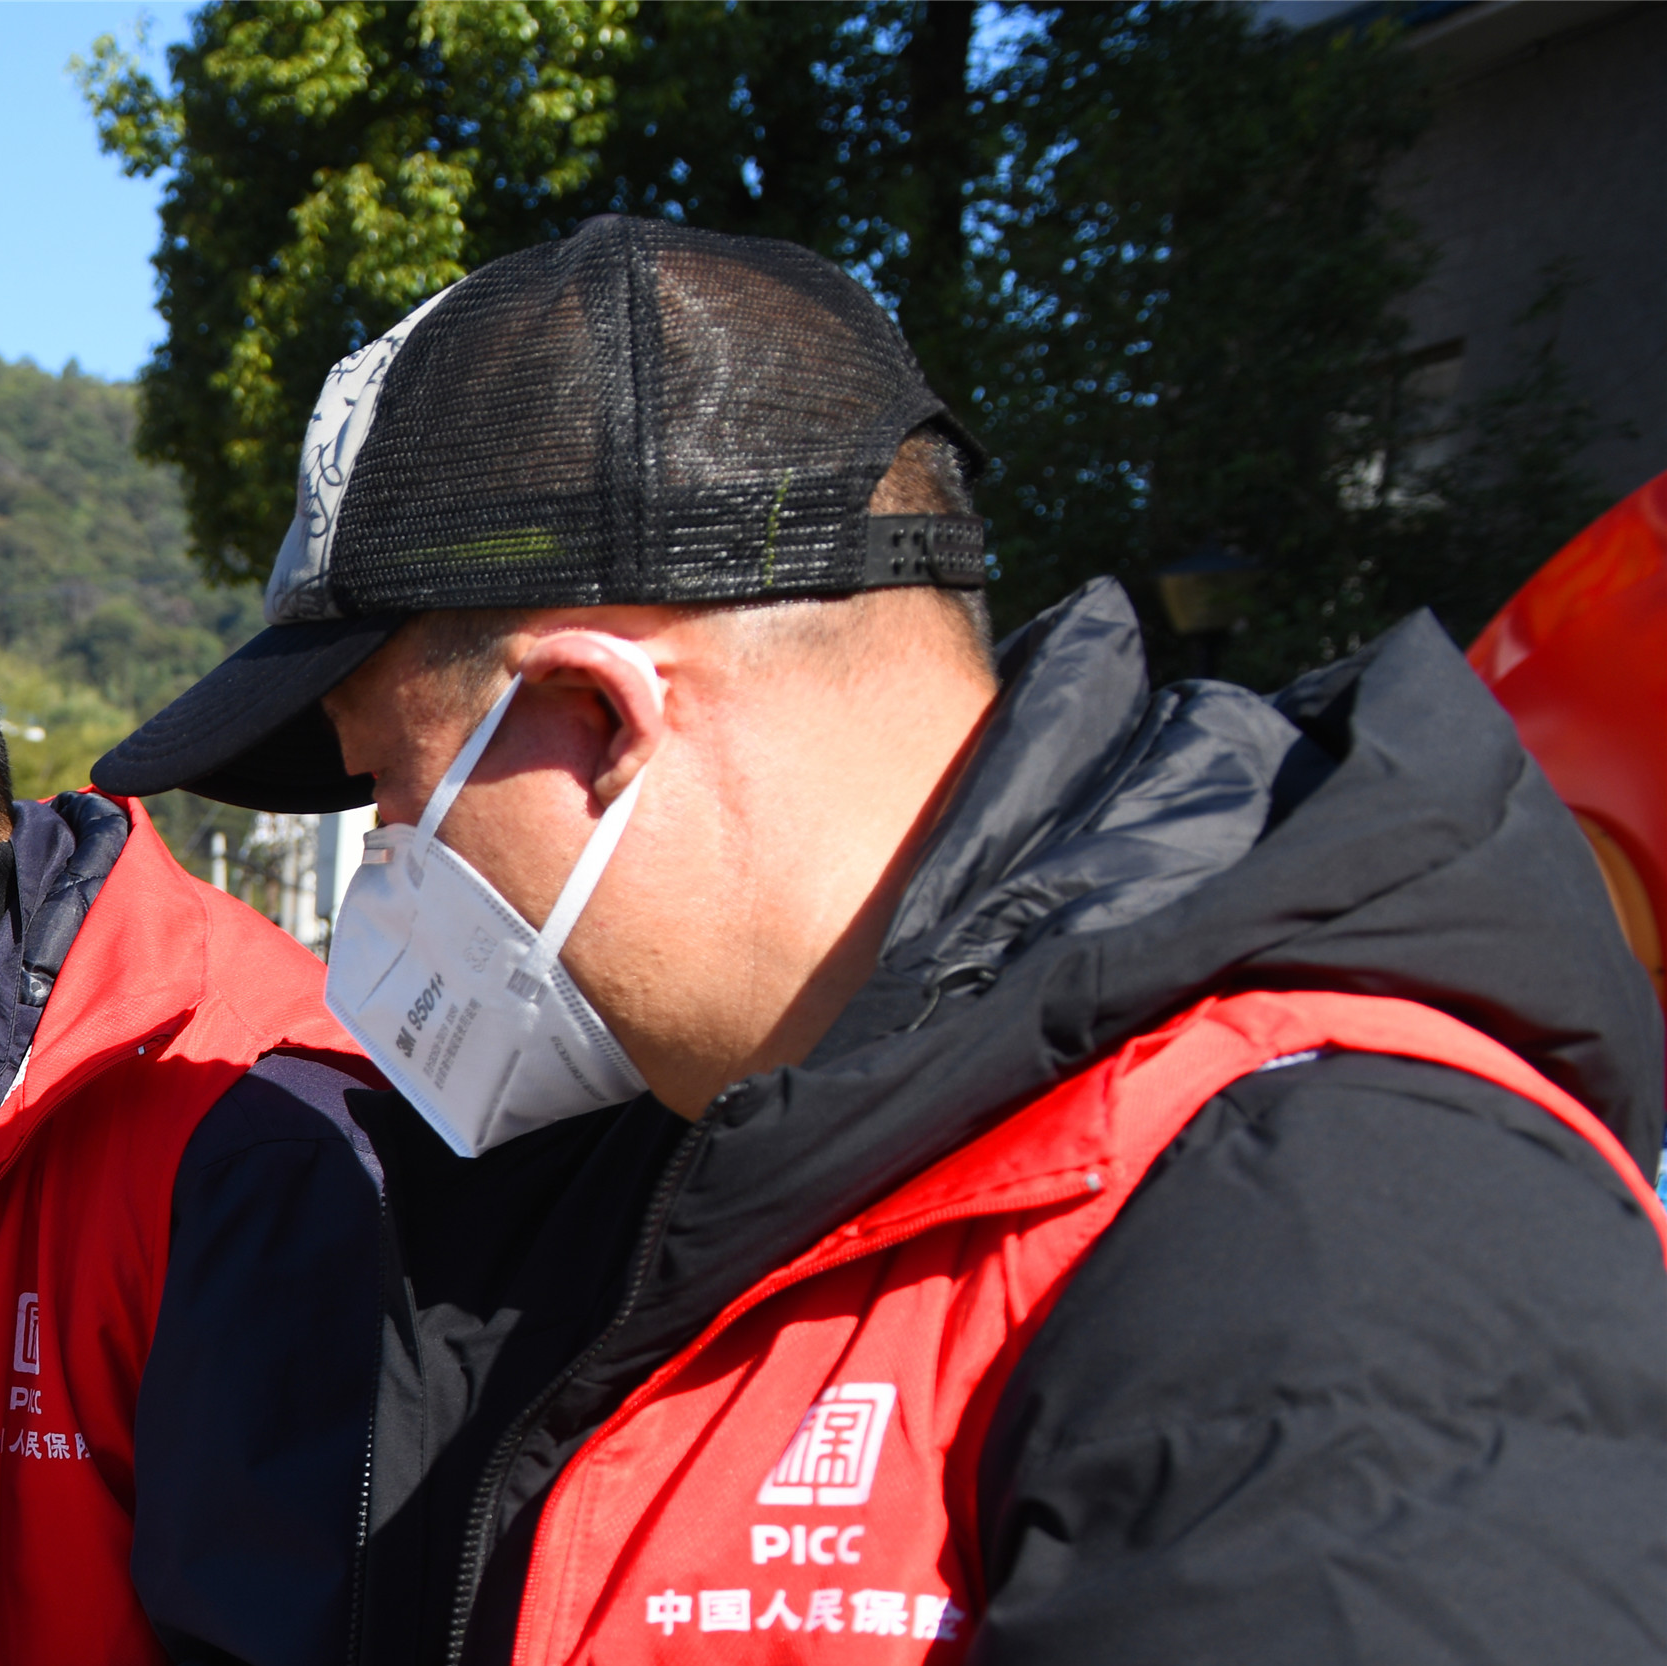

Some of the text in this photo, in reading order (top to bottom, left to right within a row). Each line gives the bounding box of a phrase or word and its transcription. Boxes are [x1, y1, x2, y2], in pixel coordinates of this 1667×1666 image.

[396, 971, 446, 1059] 3M 9501+
[750, 1524, 866, 1566] PICC
[645, 1588, 966, 1642] 中国人民保险
